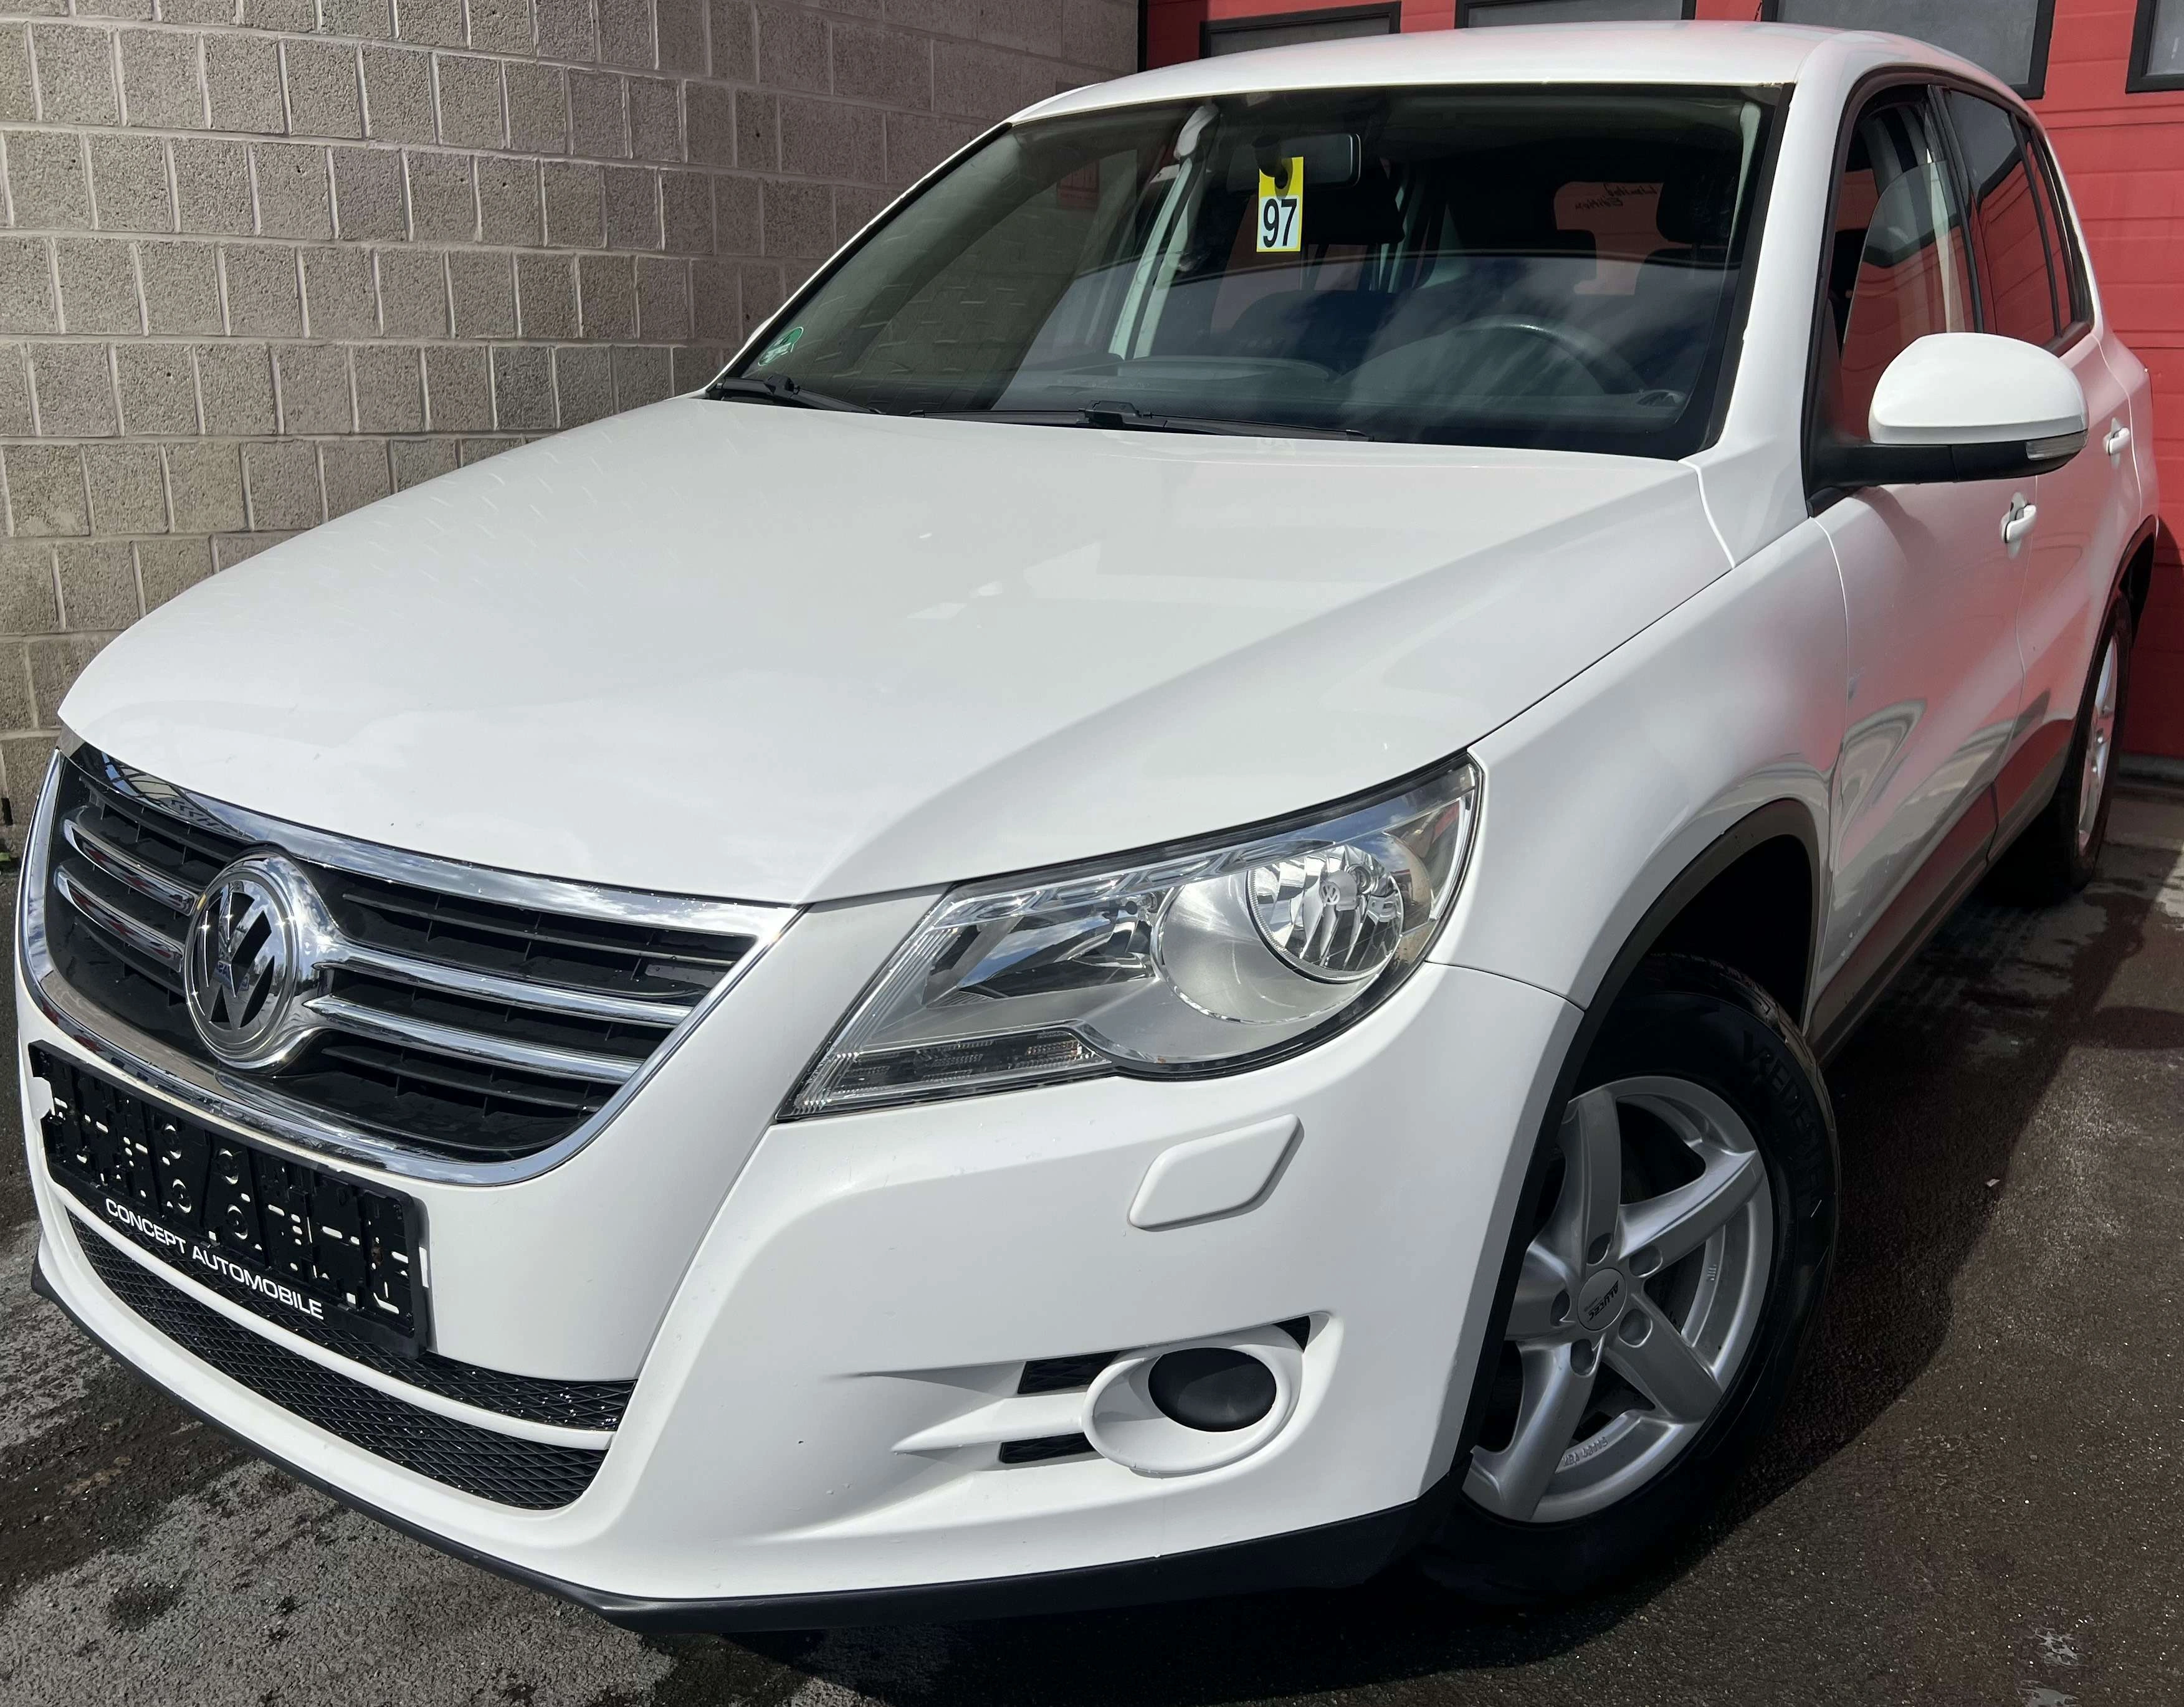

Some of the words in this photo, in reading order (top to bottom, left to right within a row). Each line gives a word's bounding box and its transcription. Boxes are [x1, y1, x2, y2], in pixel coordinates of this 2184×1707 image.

[1263, 198, 1297, 248] 97
[105, 1198, 186, 1253] CONCEPT
[192, 1245, 324, 1320] AUTOMOBILE
